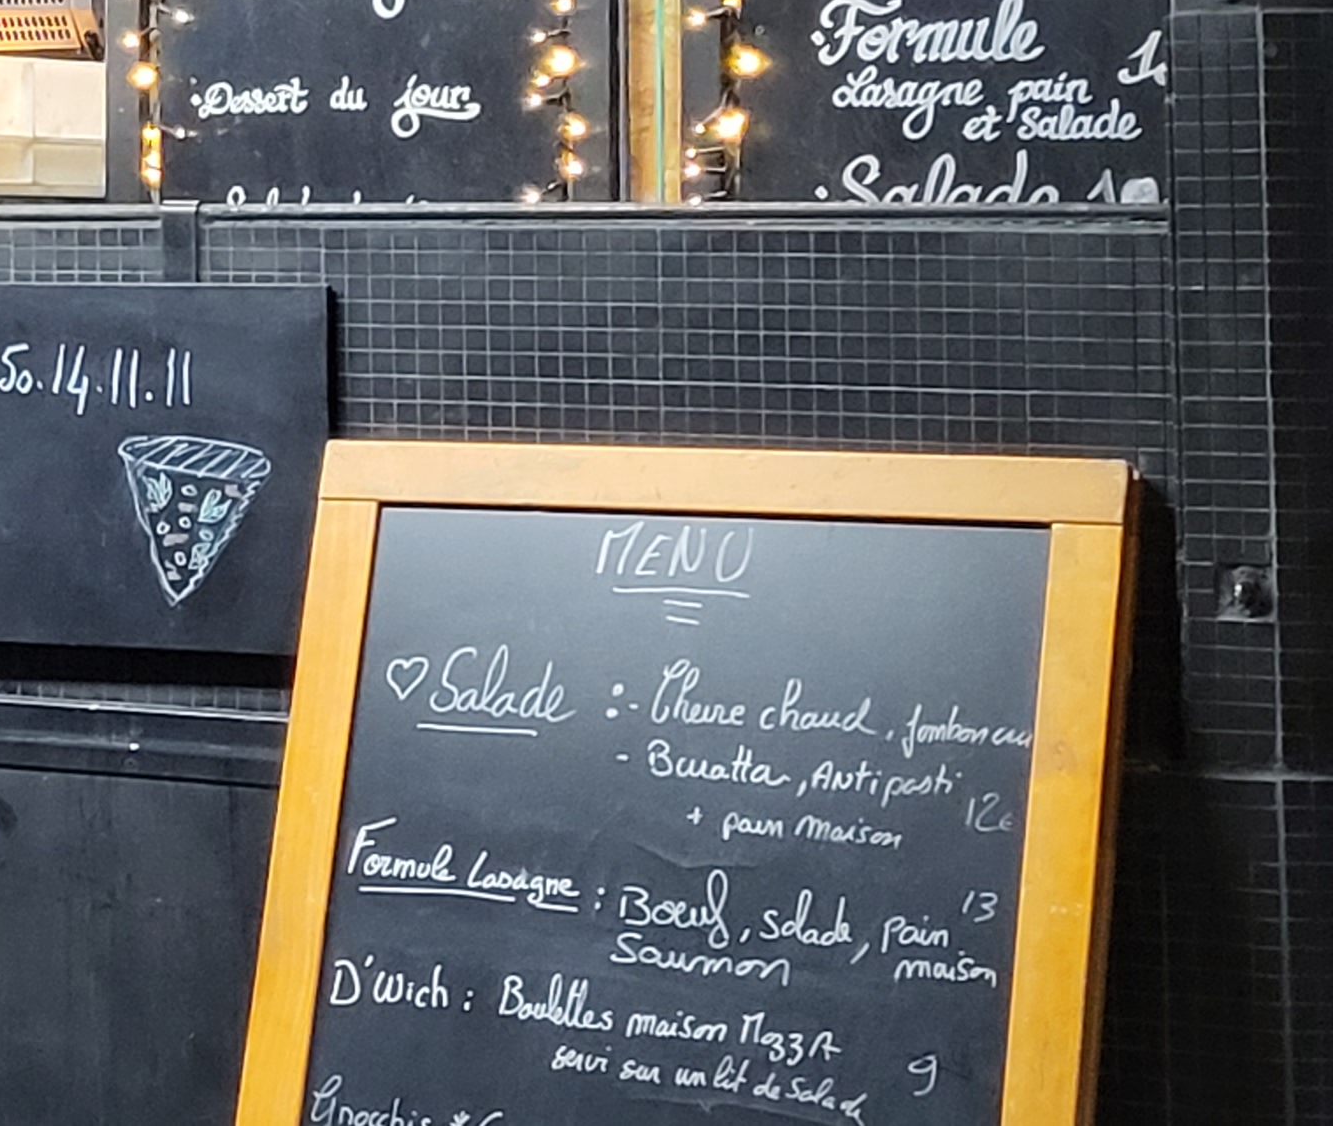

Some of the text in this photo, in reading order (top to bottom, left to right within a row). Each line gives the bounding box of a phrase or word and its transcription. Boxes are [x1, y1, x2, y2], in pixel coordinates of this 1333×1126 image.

[198, 79, 309, 120] Dessert
[329, 76, 367, 112] du
[832, 65, 1093, 140] Lasagne pain
[962, 99, 1143, 141] et Salade
[595, 519, 755, 583] MENU
[429, 643, 578, 724] Salade
[721, 812, 784, 841] pain
[794, 814, 903, 850] maison
[347, 816, 457, 882] Formule
[466, 850, 581, 904] Lasagne
[961, 889, 1000, 923] 13
[608, 931, 998, 988] Saumon maison
[498, 973, 613, 1031] Boulettes
[625, 1010, 728, 1043] maison
[551, 1043, 614, 1073] servi
[619, 1058, 662, 1085] sur
[713, 1054, 750, 1094] lit
[753, 1072, 781, 1101] de
[907, 1053, 938, 1096] 9
